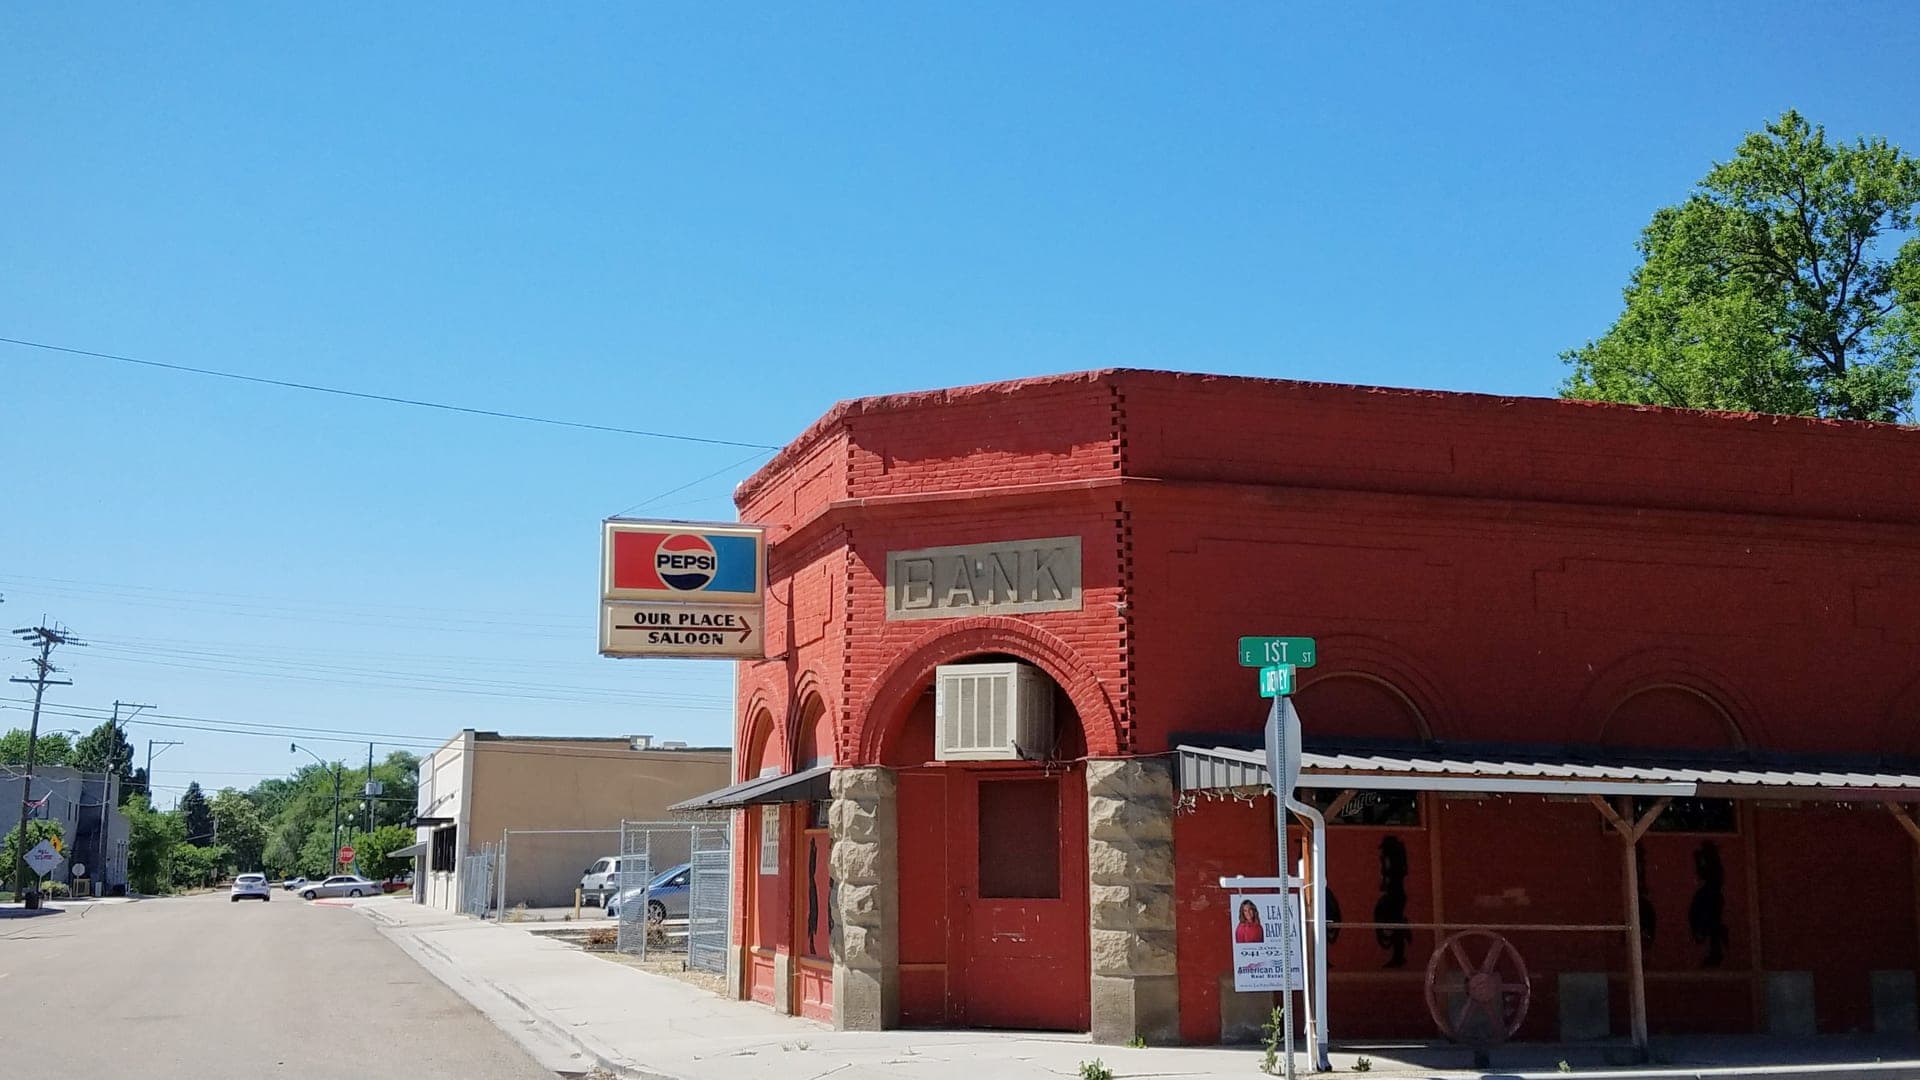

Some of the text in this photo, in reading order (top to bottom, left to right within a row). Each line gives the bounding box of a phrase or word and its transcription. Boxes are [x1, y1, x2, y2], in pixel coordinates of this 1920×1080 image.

[657, 554, 716, 570] PEPSI
[903, 547, 1068, 609] BANK
[634, 612, 735, 627] OUR PLACE
[648, 631, 723, 645] SALOON
[1245, 641, 1312, 663] E 1ST ST
[1266, 905, 1294, 920] LEAN
[1237, 965, 1300, 975] American Drm
